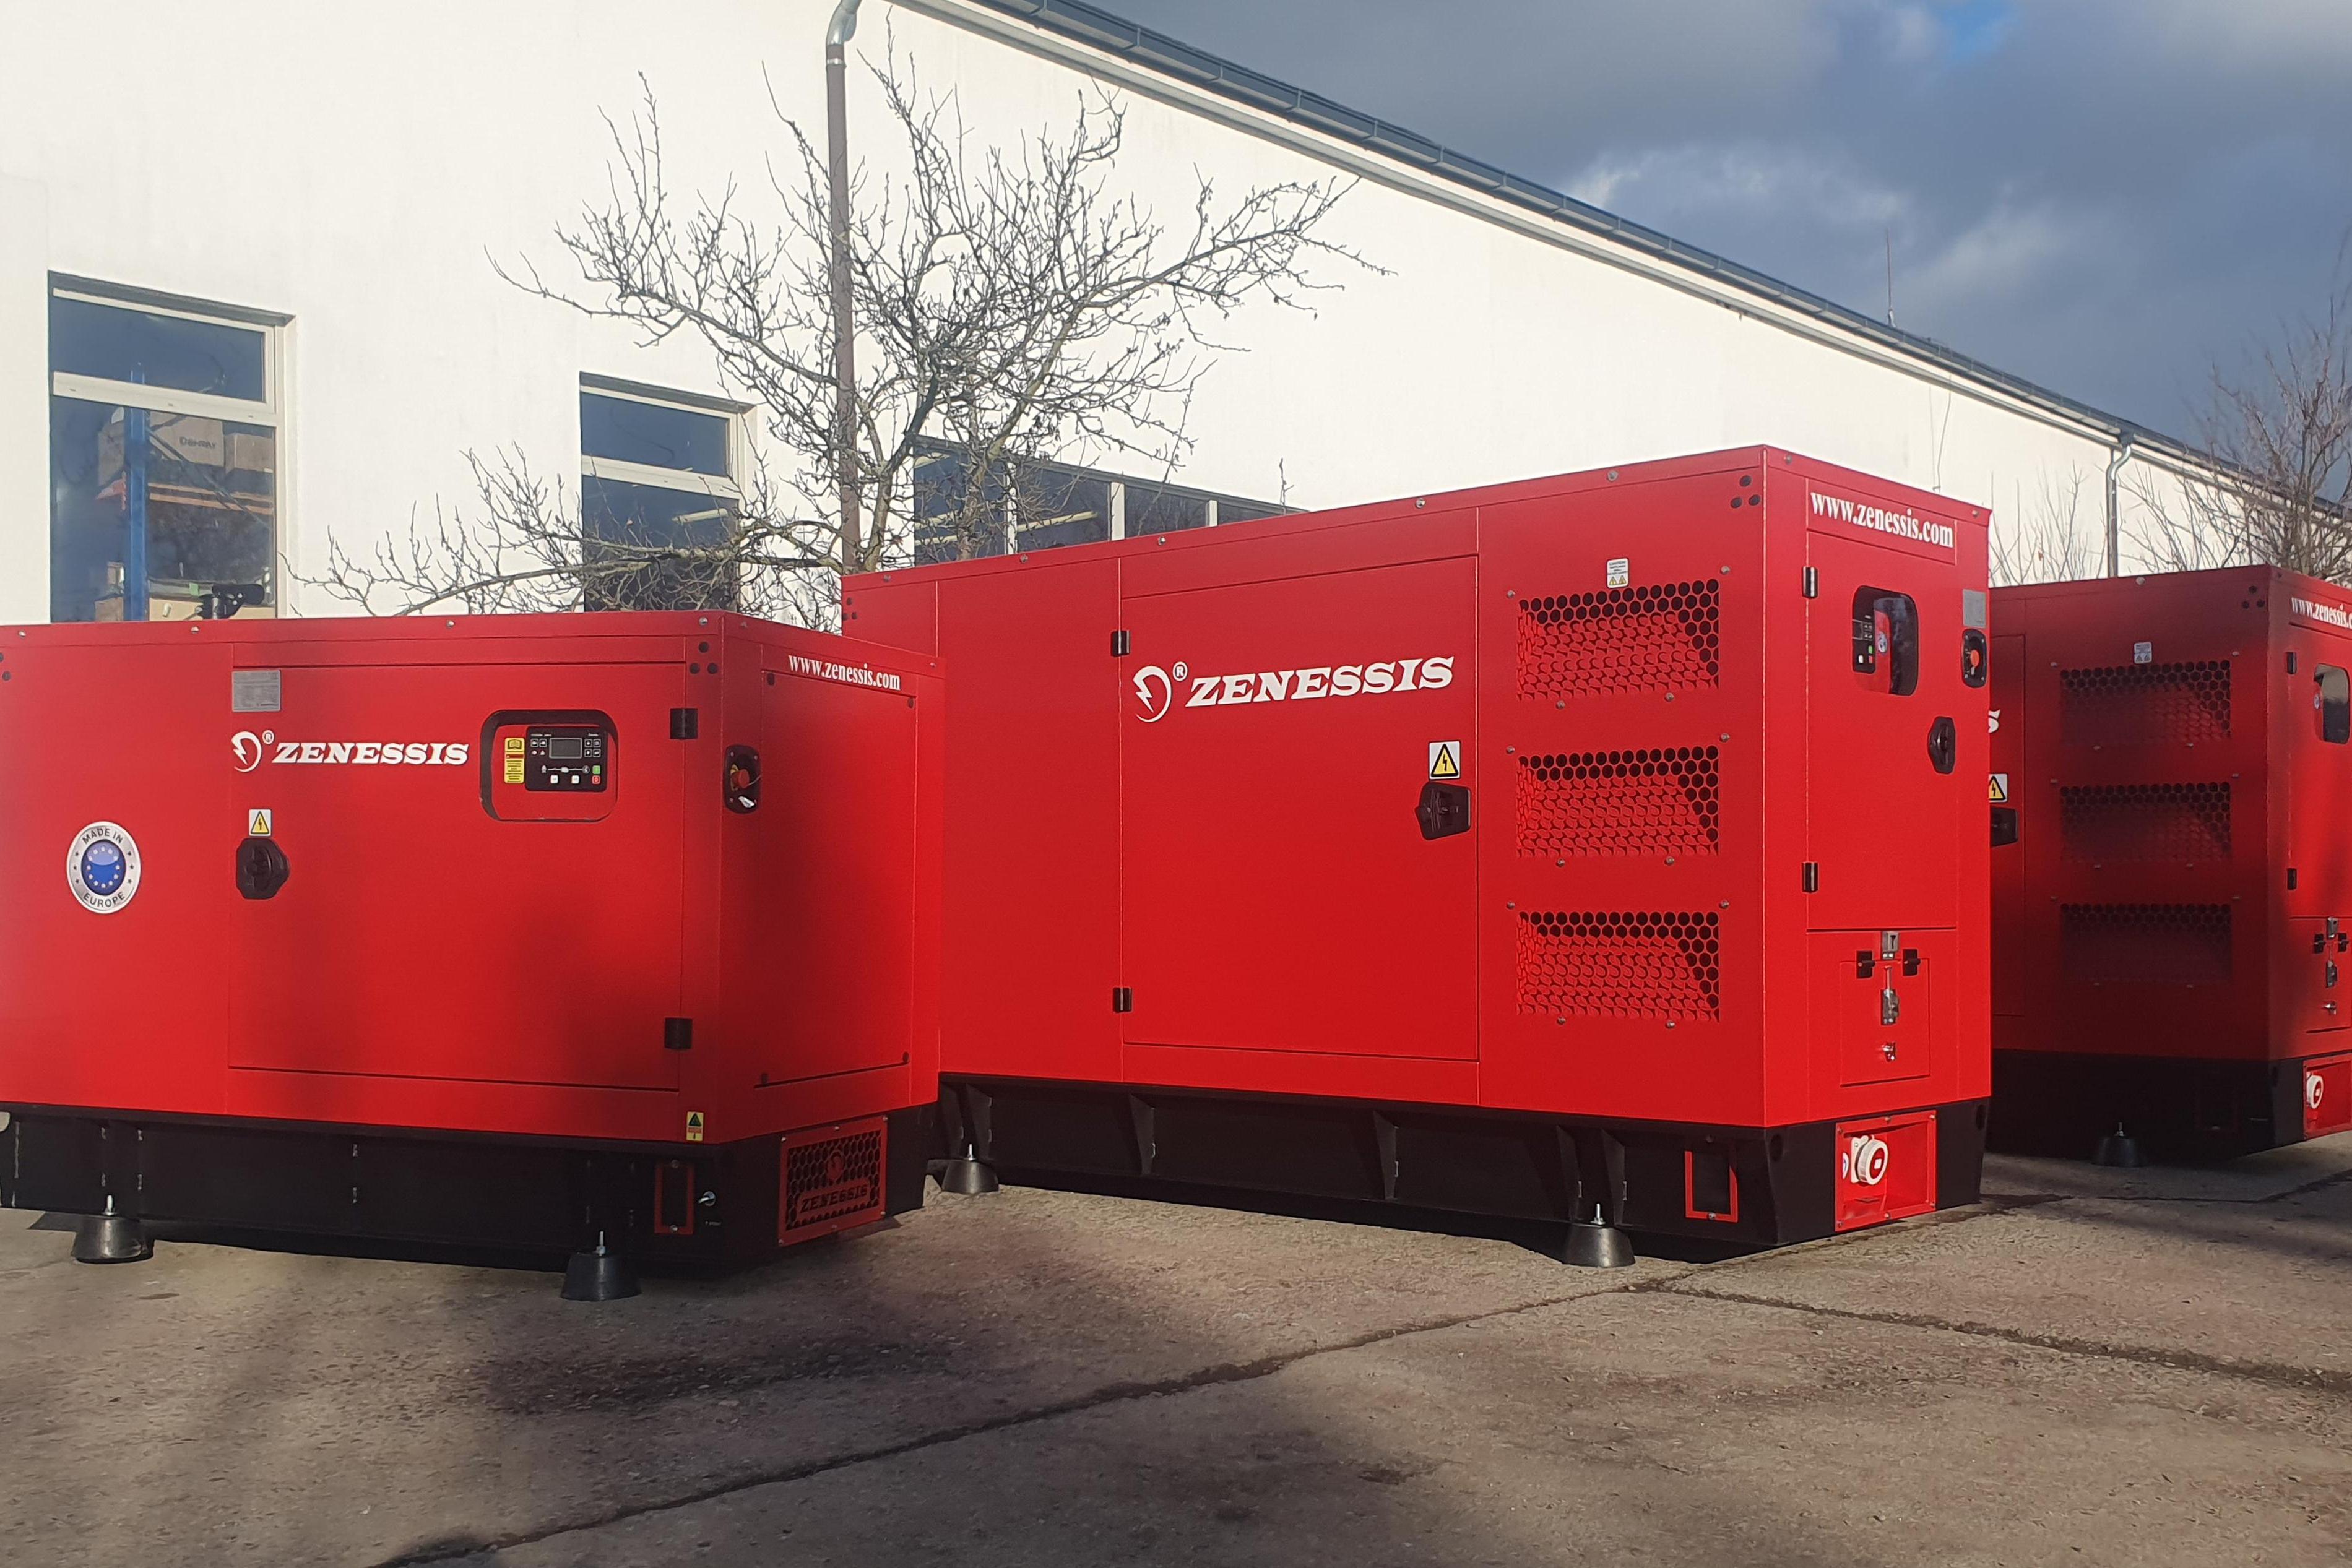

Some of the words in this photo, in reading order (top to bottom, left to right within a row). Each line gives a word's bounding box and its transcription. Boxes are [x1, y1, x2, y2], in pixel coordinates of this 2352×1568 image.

[1810, 492, 1953, 548] www.zenessis.com
[788, 655, 901, 691] www.zenessis.com
[1185, 655, 1455, 707] ZENESSIS
[272, 742, 470, 765] ZENESSIS
[82, 828, 111, 845] MADE
[112, 831, 124, 844] IN
[83, 891, 125, 908] EUROPE
[800, 1184, 867, 1213] ZENESSIS
